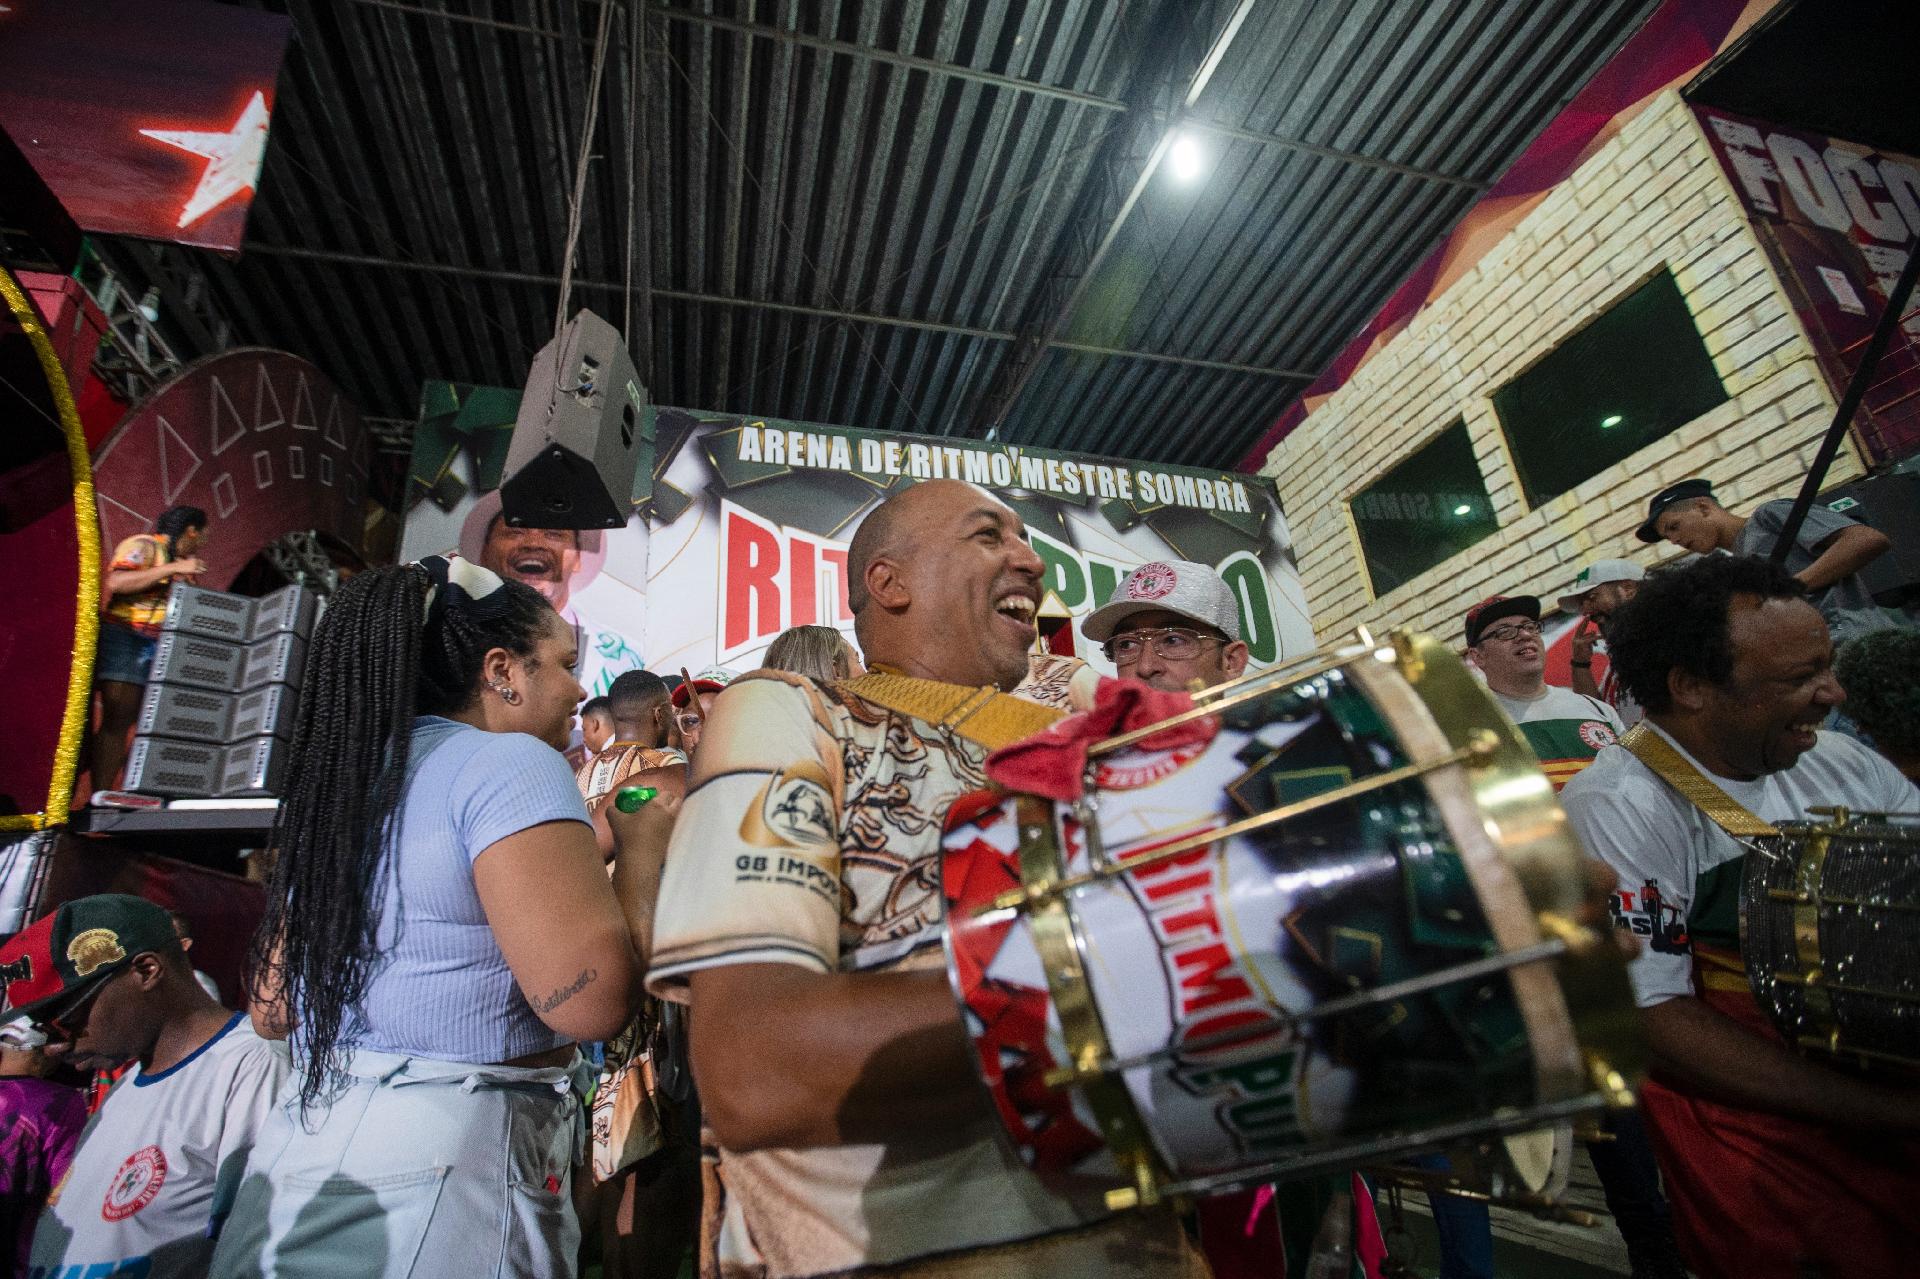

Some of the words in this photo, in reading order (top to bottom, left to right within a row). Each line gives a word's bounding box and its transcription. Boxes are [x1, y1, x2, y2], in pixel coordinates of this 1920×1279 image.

[738, 426, 851, 471] ARENA
[861, 438, 902, 476] DE
[908, 443, 1012, 487] RITMO
[1020, 456, 1133, 500] MESTRE
[1139, 470, 1250, 513] SOMBRA
[724, 511, 855, 650] RIT
[736, 855, 767, 872] GB
